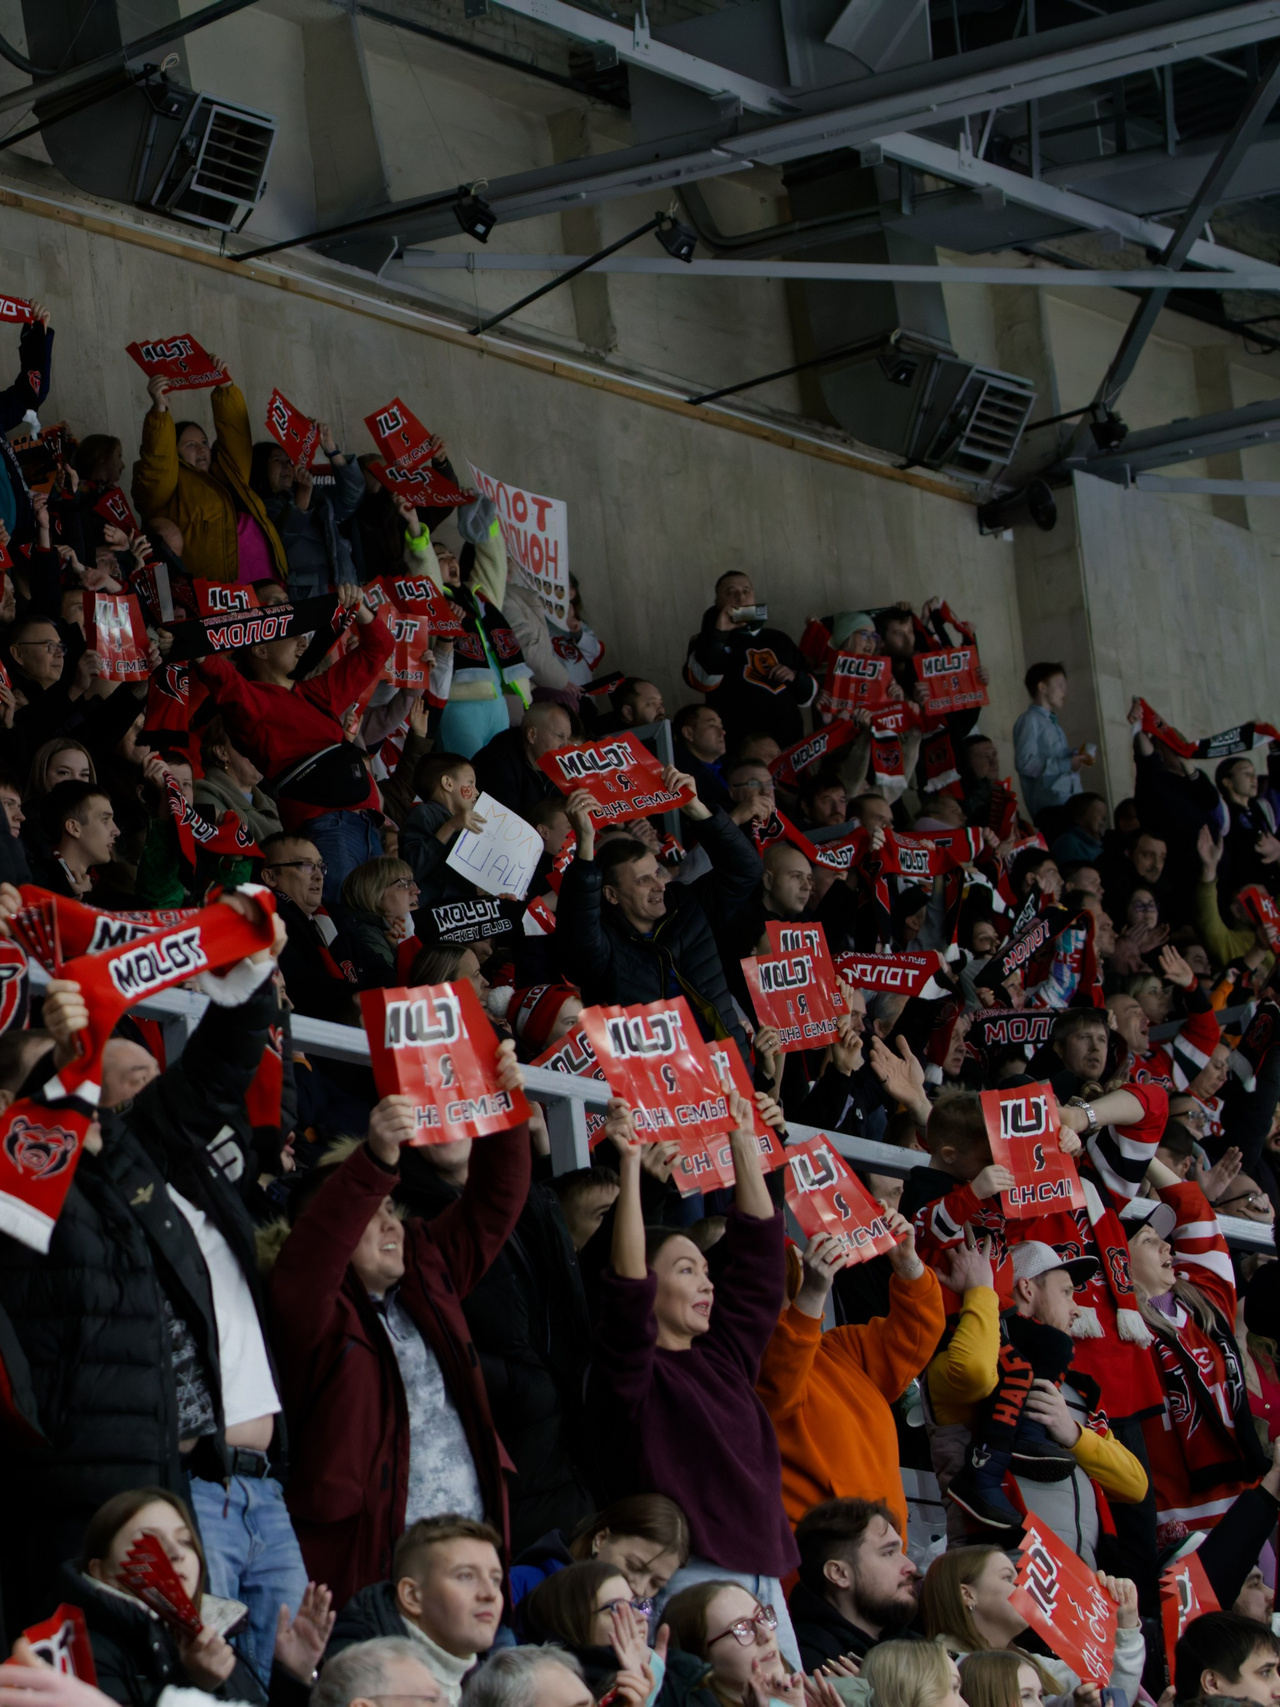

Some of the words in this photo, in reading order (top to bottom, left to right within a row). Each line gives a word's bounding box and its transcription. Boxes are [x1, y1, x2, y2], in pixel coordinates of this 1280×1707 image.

[206, 614, 295, 651] МОЛОТ
[431, 898, 501, 933] MOLOT
[481, 918, 514, 937] CLUB
[107, 925, 209, 999] MOLOT
[841, 962, 921, 989] МОЛОТ
[384, 995, 470, 1051] MOLO
[983, 1015, 1054, 1045] МОЛ
